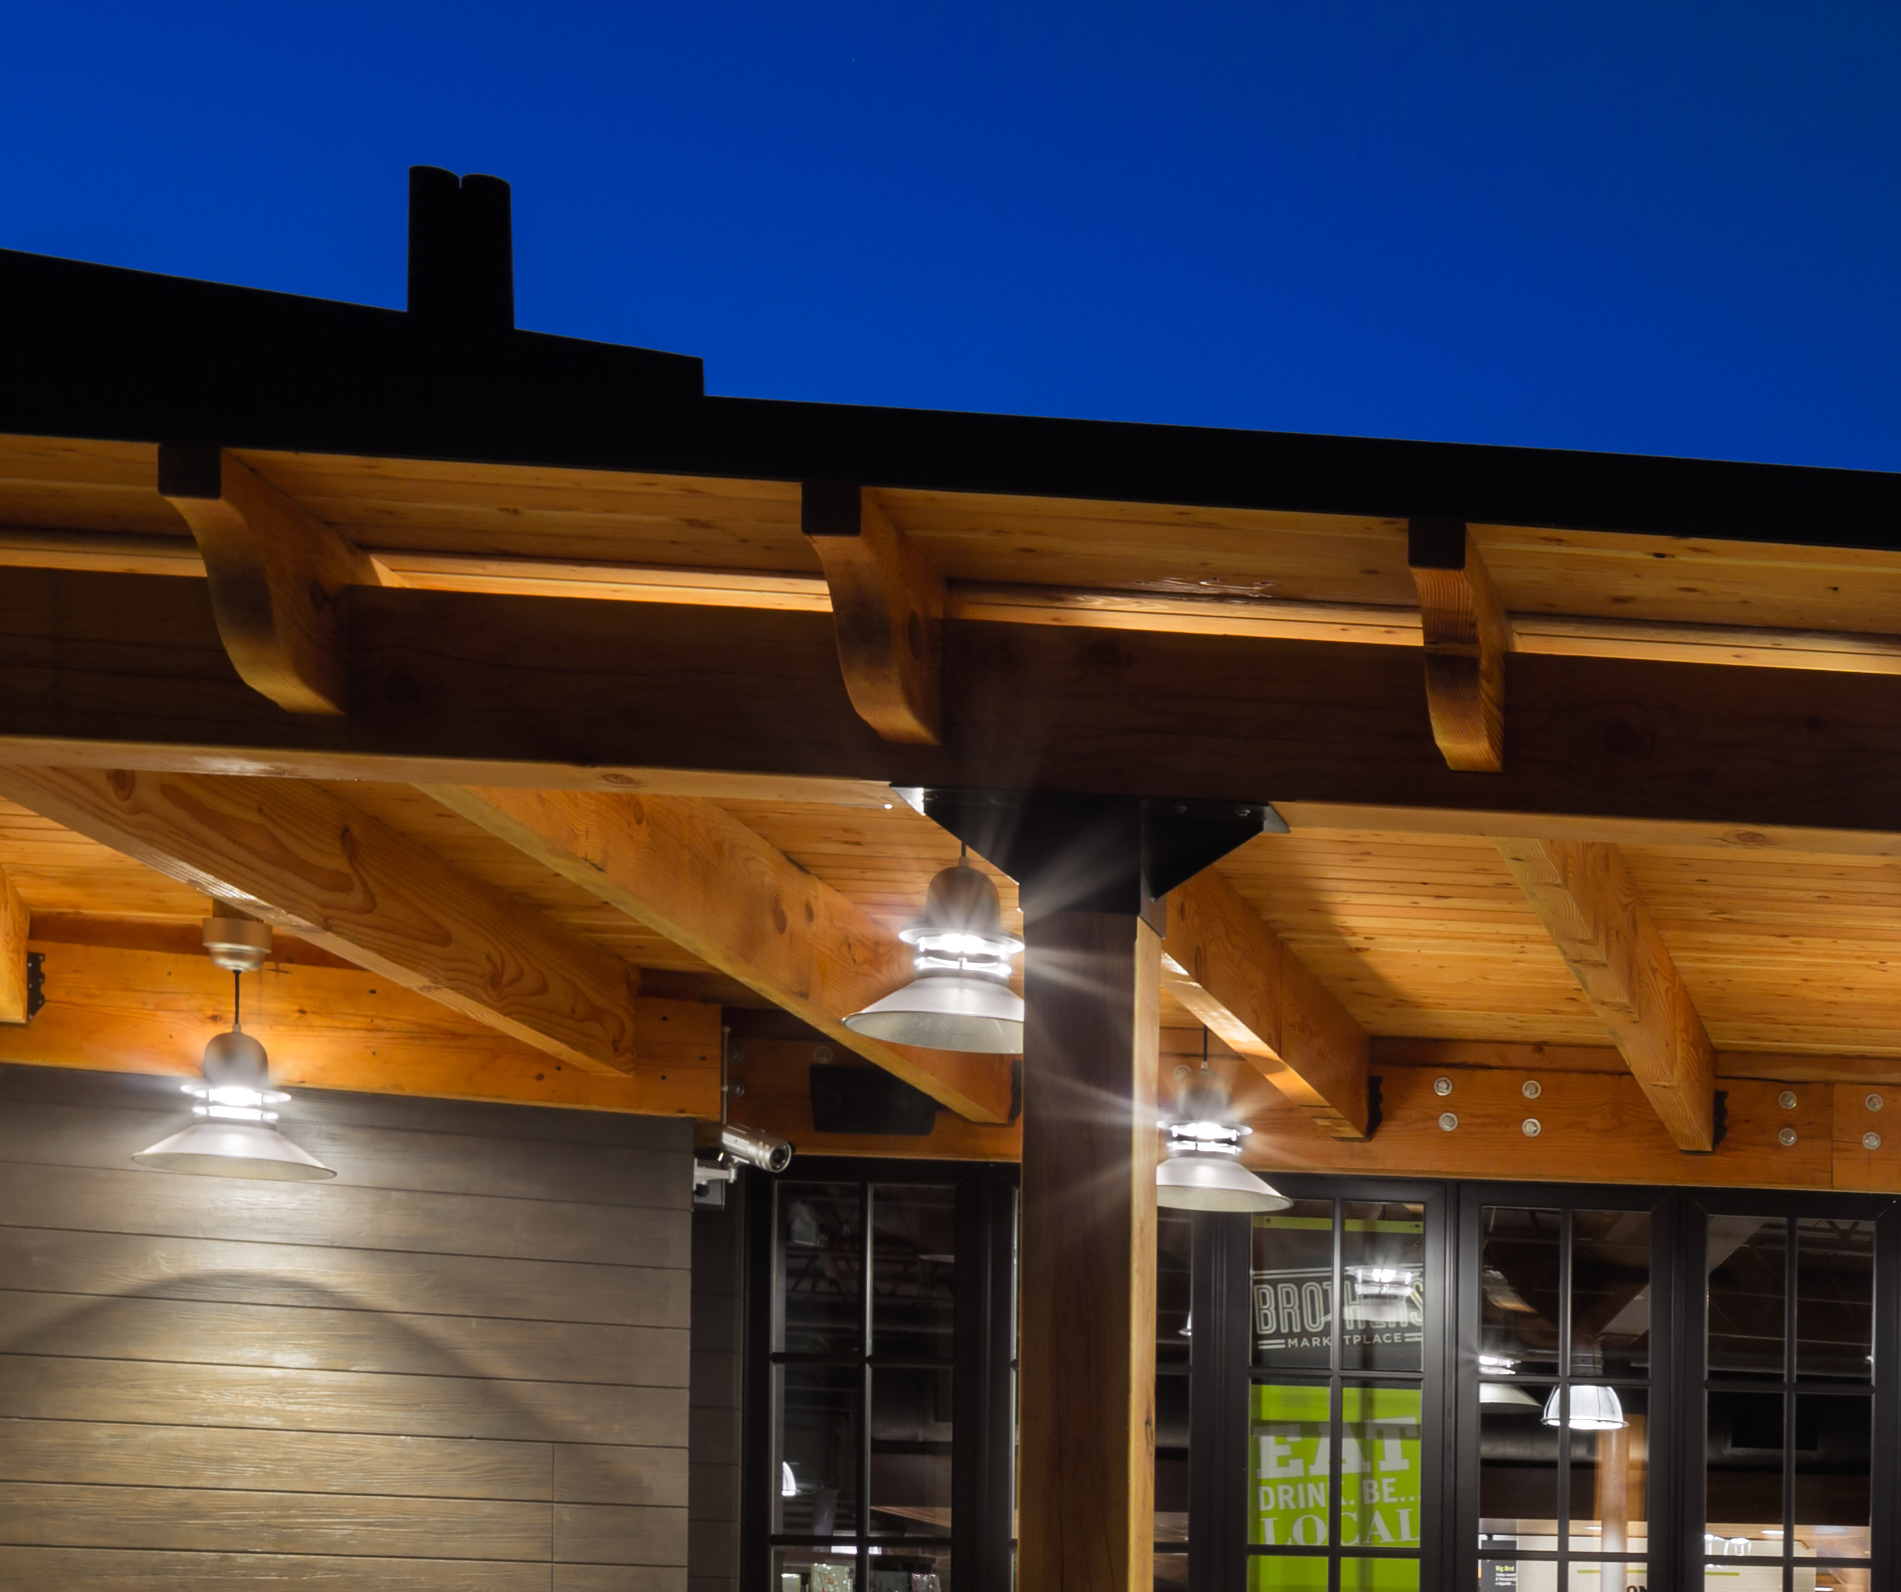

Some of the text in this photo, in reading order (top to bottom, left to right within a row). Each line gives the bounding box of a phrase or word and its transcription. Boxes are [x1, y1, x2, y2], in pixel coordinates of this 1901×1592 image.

[1288, 1332, 1402, 1347] MARKTPLACE
[1253, 1416, 1419, 1479] EAT
[1257, 1482, 1355, 1512] DRIN.
[1260, 1508, 1421, 1546] LOCAL
